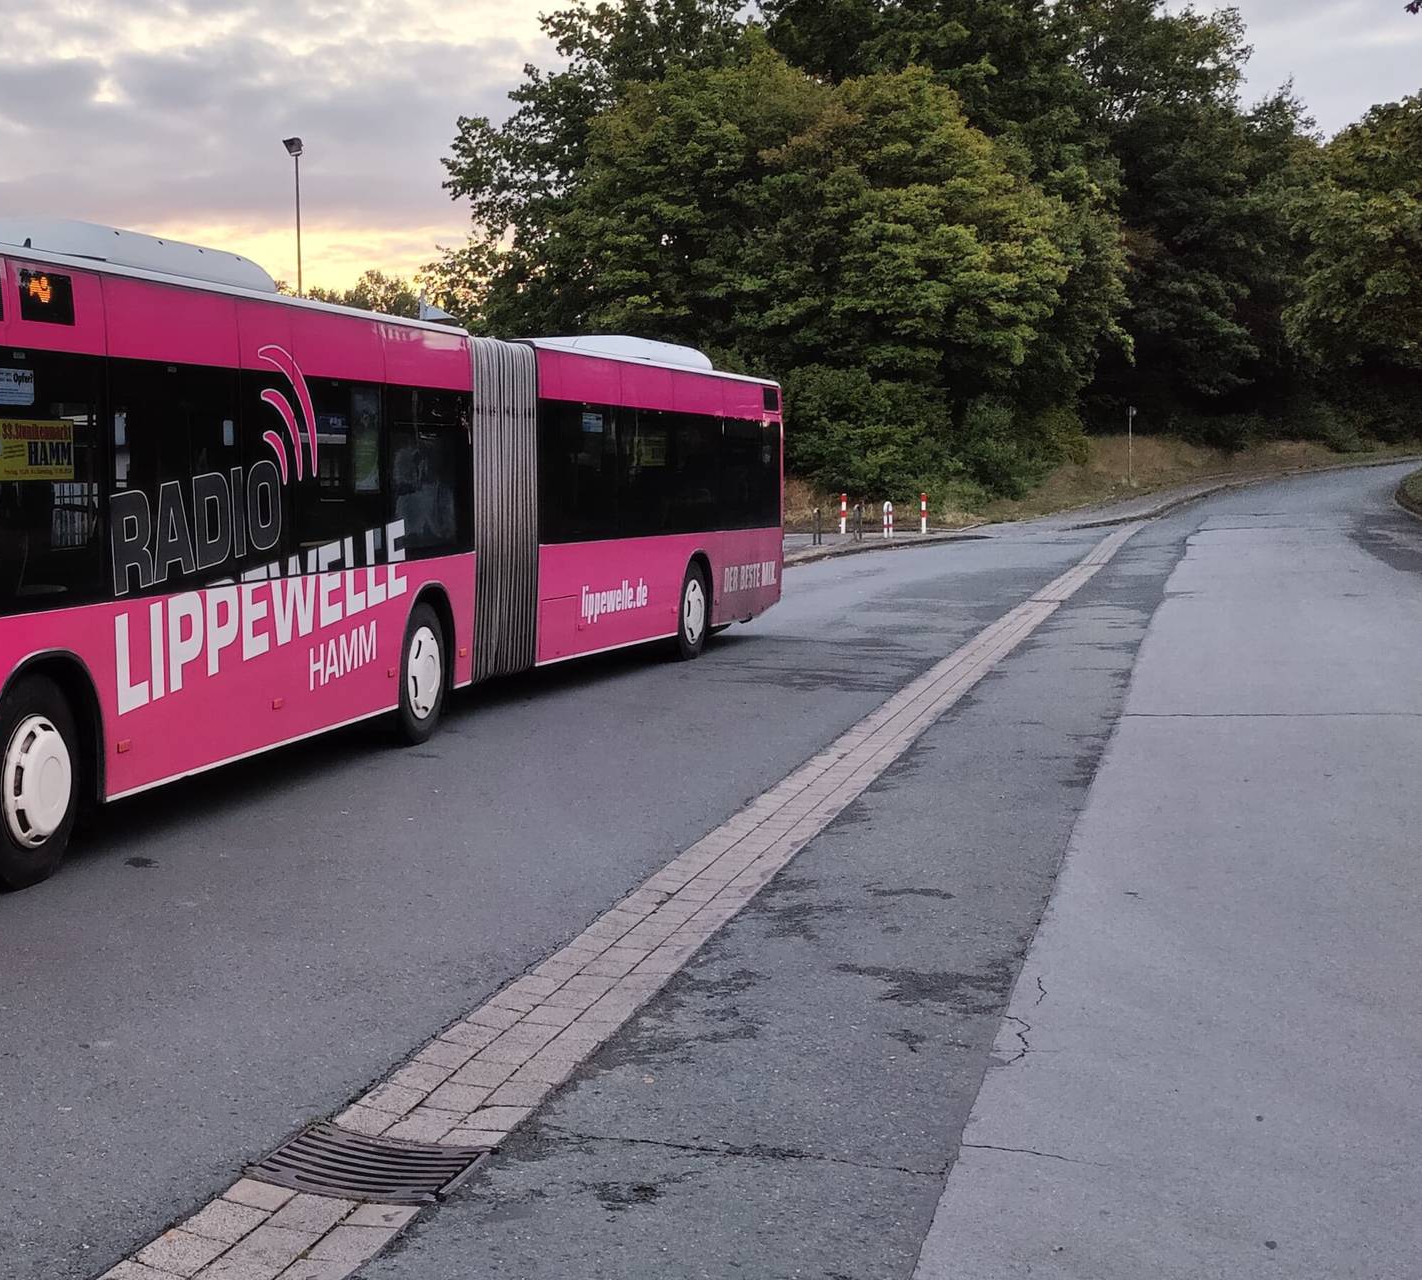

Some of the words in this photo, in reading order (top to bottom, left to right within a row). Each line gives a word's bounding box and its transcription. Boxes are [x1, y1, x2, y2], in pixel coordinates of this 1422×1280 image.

[27, 441, 72, 466] HAMM
[110, 460, 282, 596] RADIO
[581, 577, 648, 625] lippewelle.de
[723, 566, 739, 593] DER
[739, 562, 761, 590] BESTE
[115, 519, 408, 716] LIPPEWELLE
[309, 620, 377, 691] HAMM
